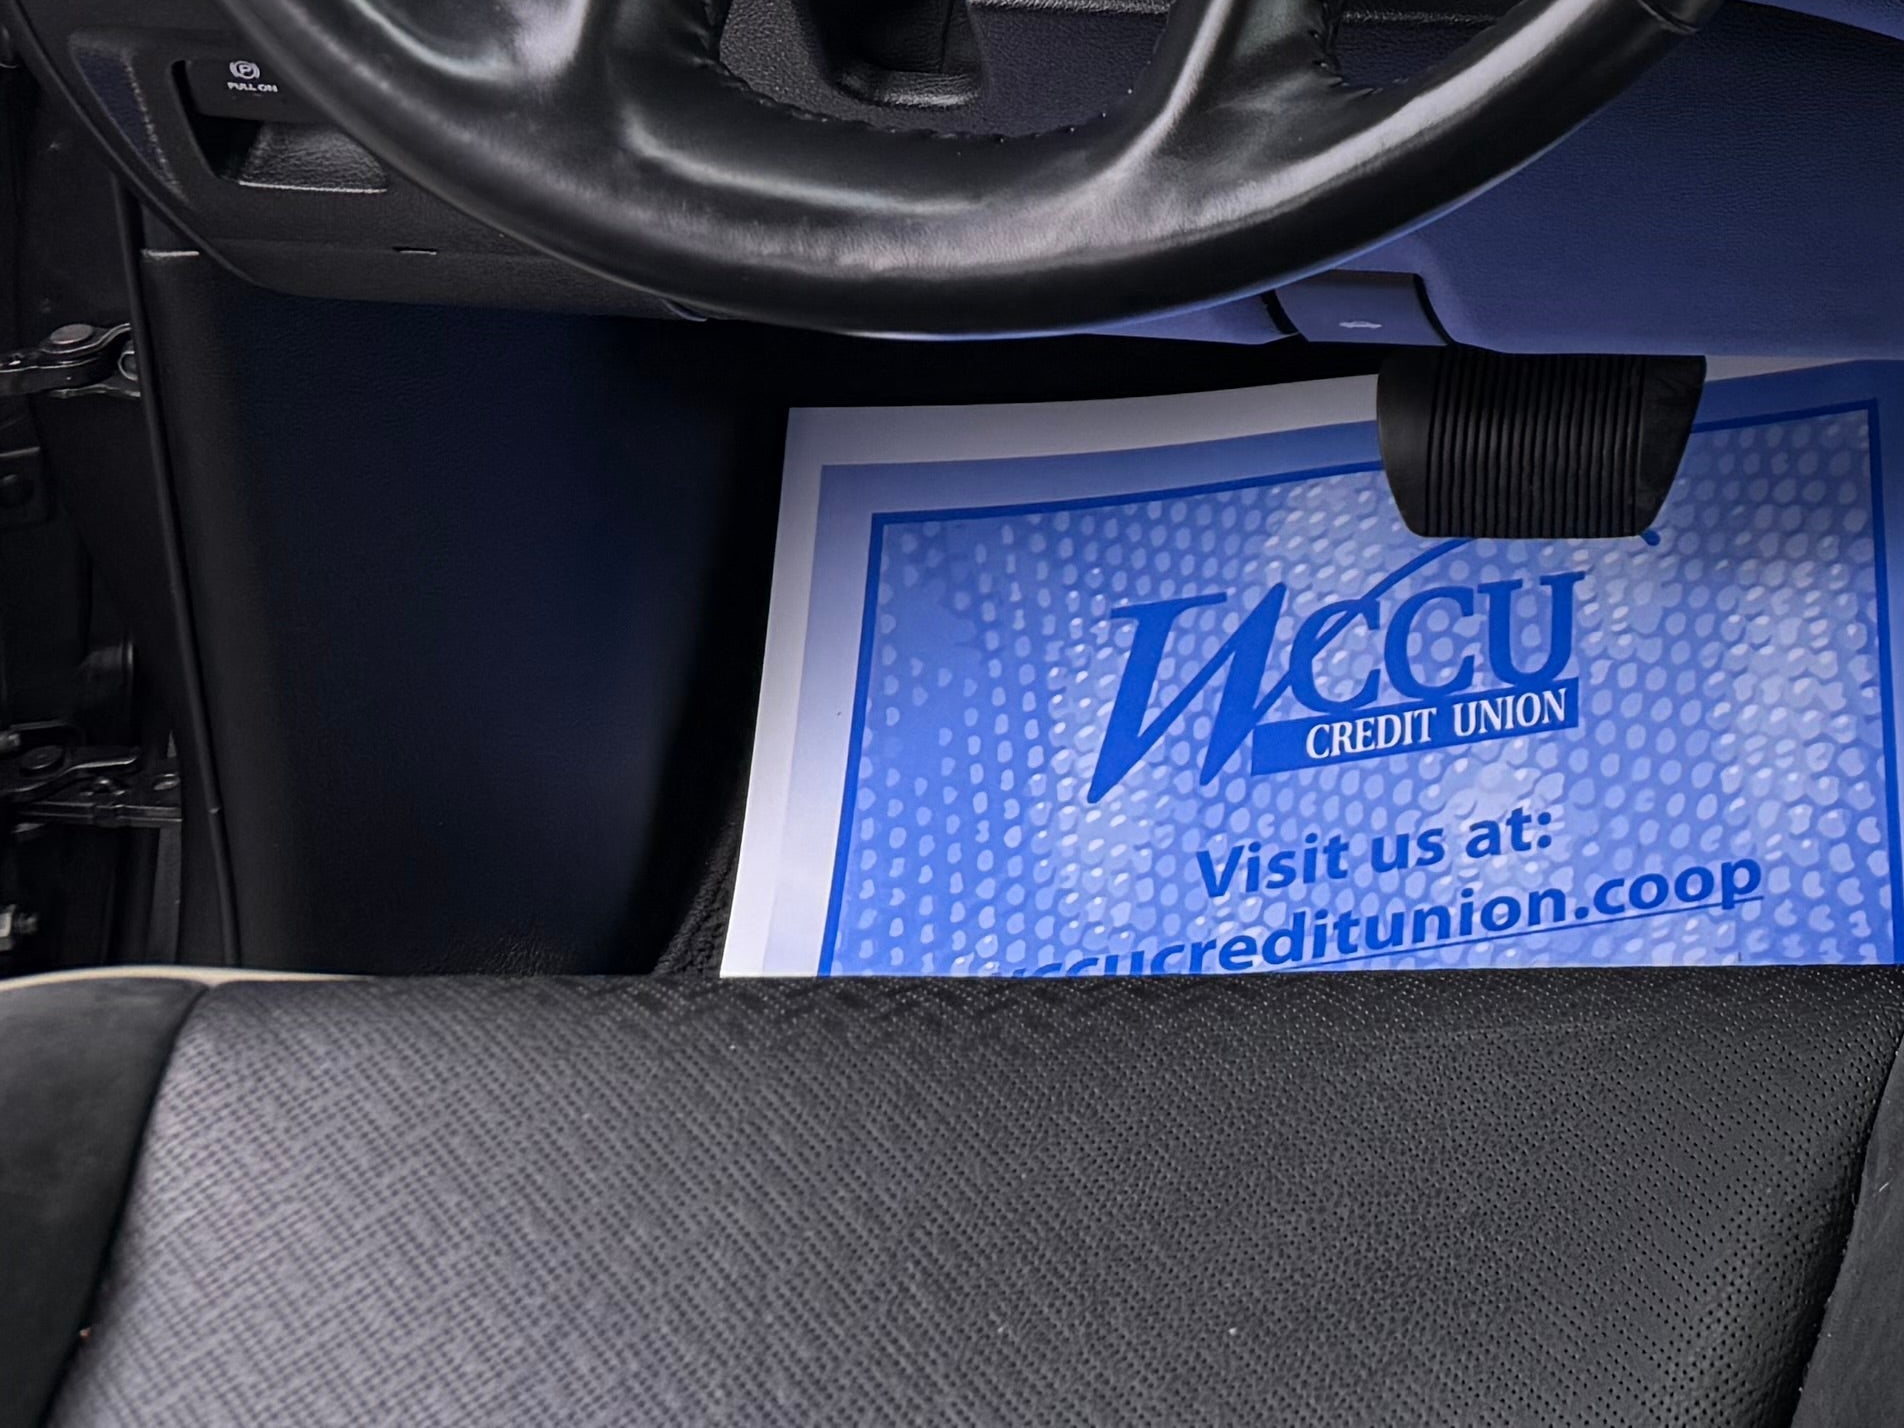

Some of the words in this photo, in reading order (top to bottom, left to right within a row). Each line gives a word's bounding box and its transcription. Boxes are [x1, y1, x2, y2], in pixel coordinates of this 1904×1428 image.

[1304, 710, 1437, 761] CREDIT
[1452, 688, 1568, 739] UNION
[1196, 834, 1350, 899] Visit
[1370, 824, 1446, 874] us
[1464, 805, 1554, 859] at:
